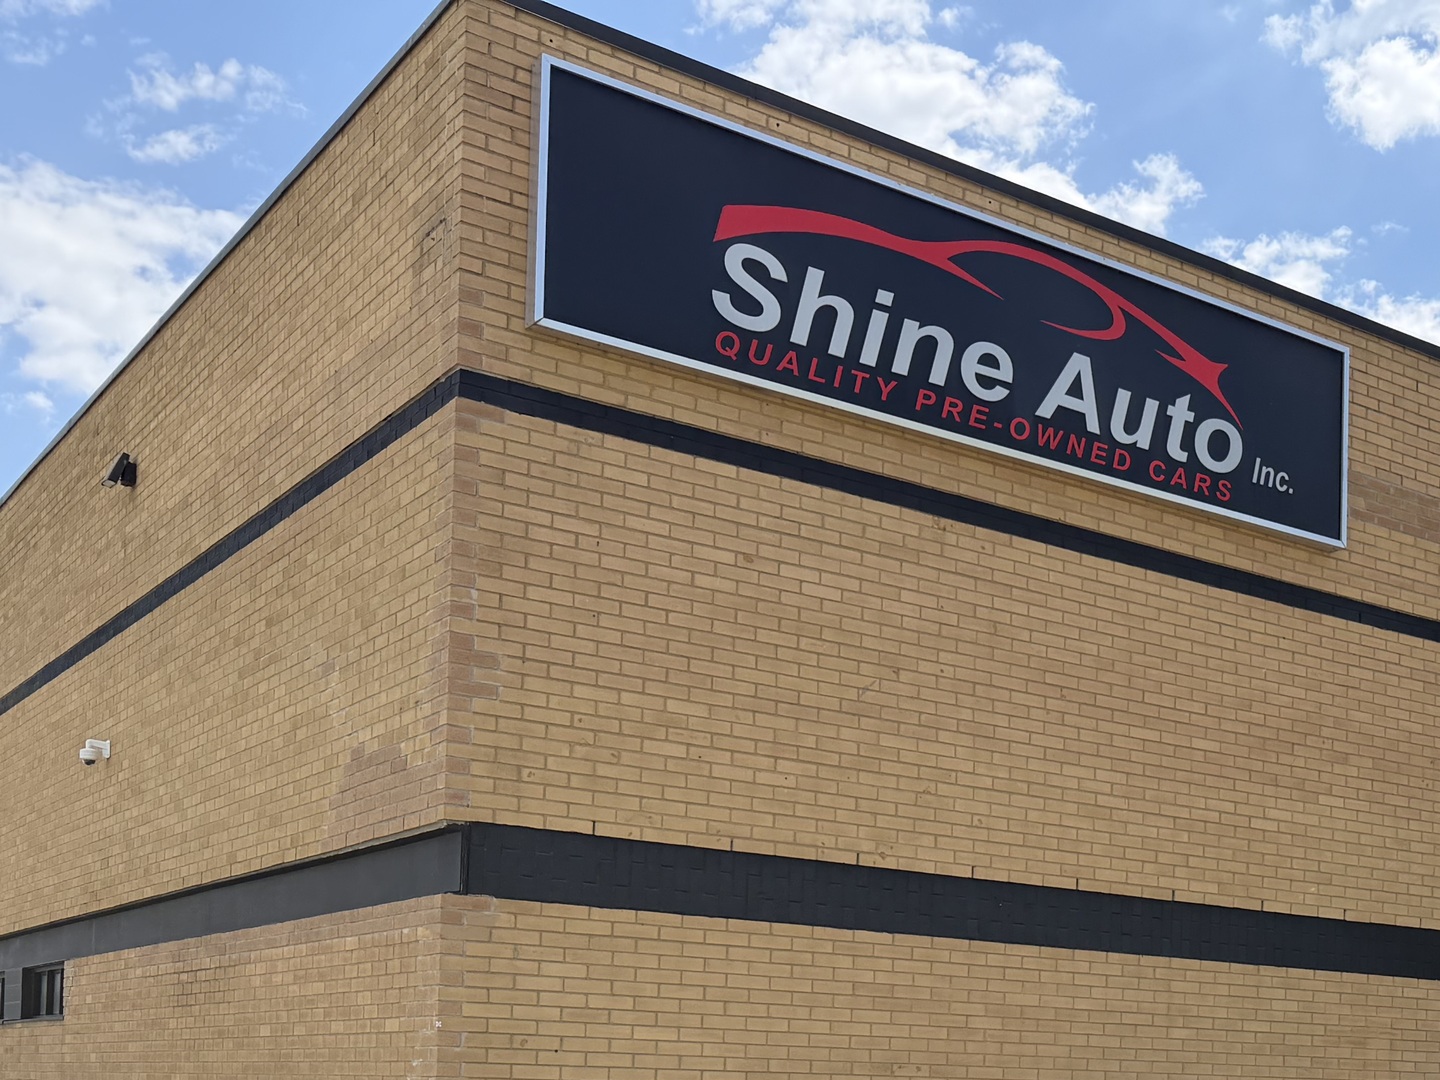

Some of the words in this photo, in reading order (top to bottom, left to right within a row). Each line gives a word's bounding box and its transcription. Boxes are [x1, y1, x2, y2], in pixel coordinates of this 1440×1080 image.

[712, 243, 1014, 402] Shine
[1034, 352, 1243, 474] Auto
[1252, 457, 1294, 494] Inc.
[715, 331, 898, 401] QUALITY
[915, 389, 1131, 471] PRE-OWNED
[1149, 460, 1232, 501] CARS
